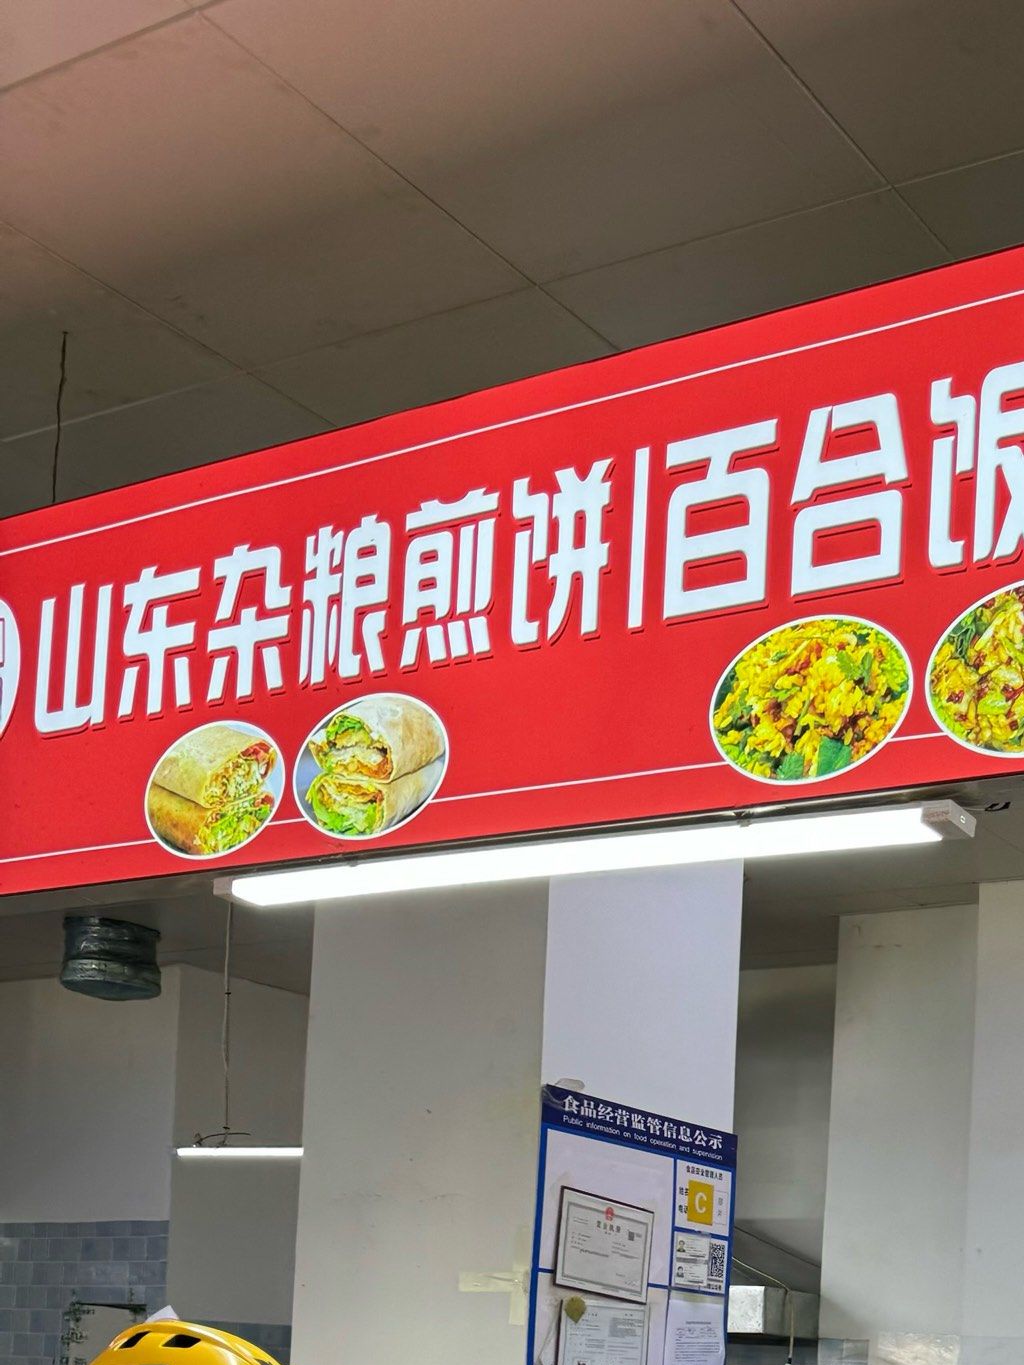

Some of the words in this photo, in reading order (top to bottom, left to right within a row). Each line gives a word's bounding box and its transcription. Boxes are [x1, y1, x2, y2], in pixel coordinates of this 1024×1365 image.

[34, 458, 613, 734] 山东杂粮煎饼
[563, 1095, 723, 1150] 食品经营监管信息公示
[563, 1114, 583, 1127] Public
[586, 1122, 621, 1136] information
[634, 1133, 648, 1142] food
[650, 1137, 677, 1149] operation
[679, 1144, 690, 1152] and
[695, 1192, 708, 1214] C
